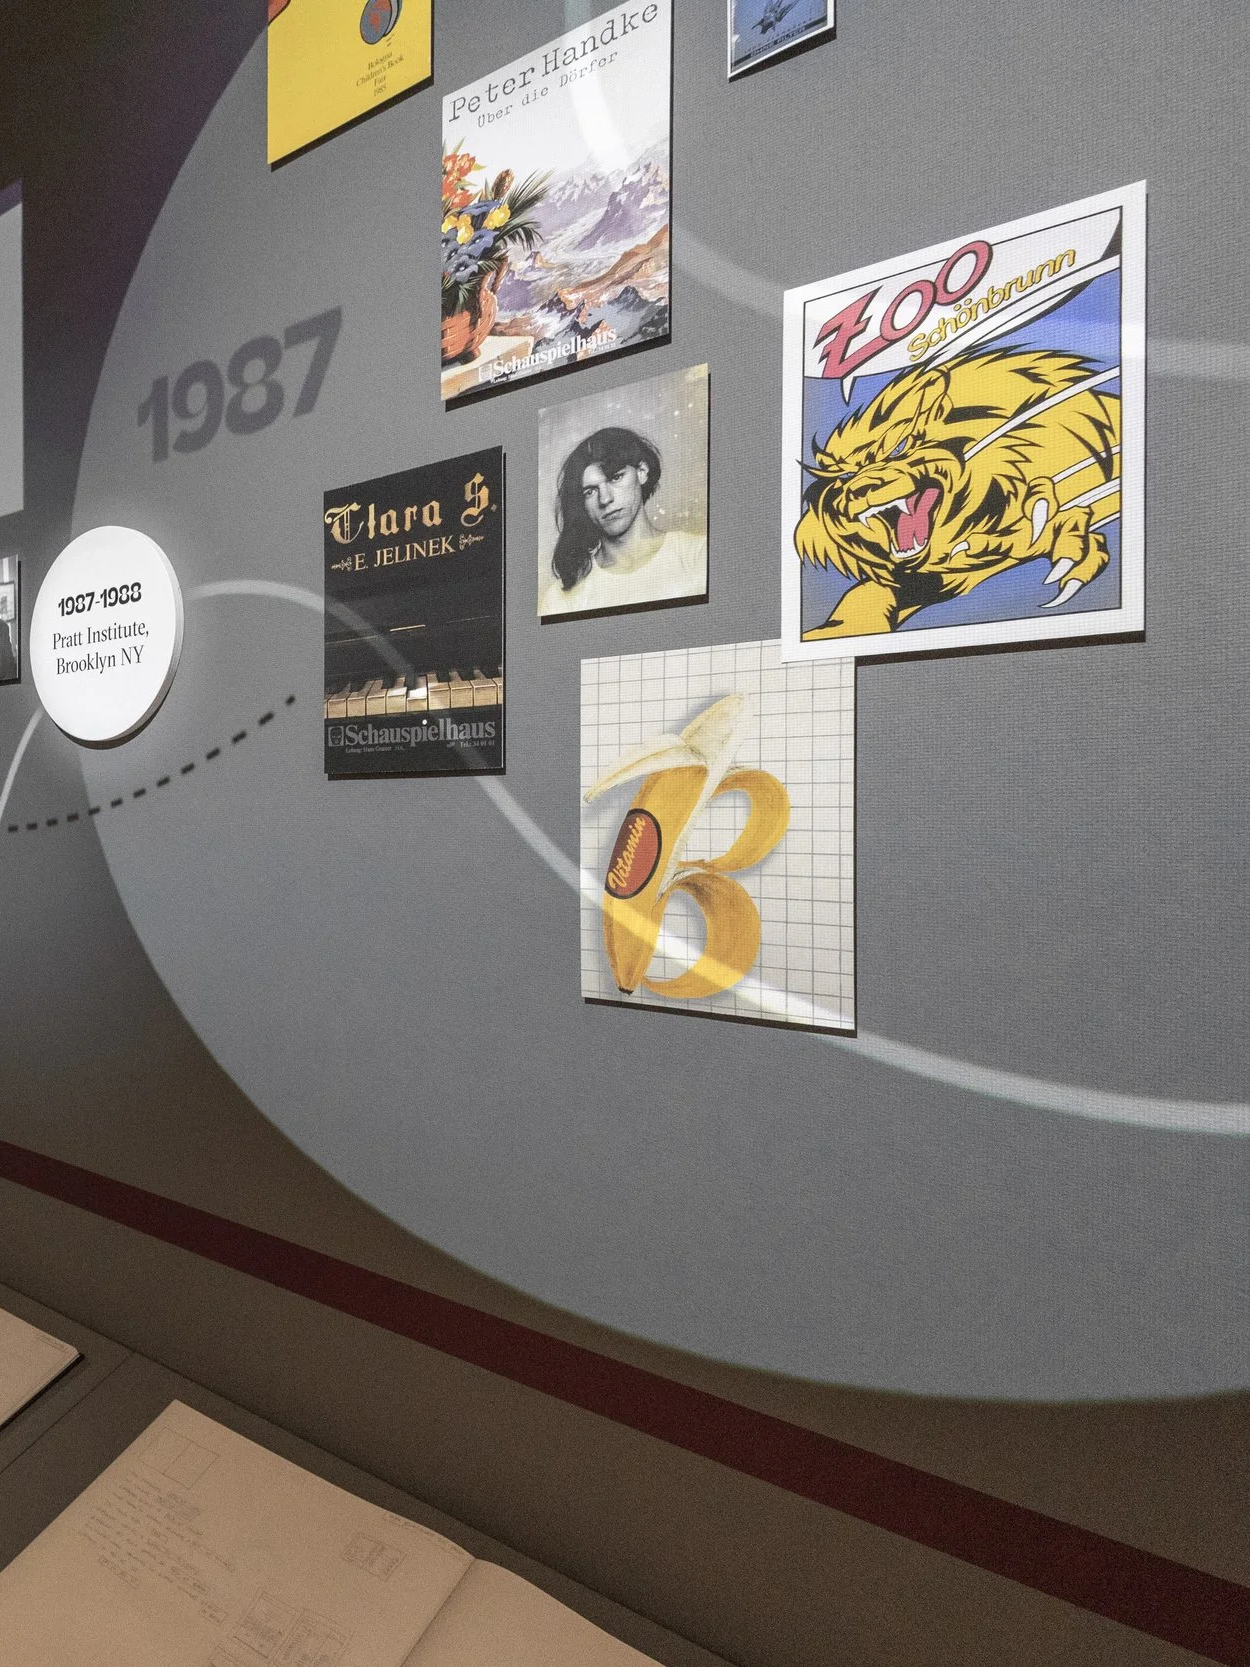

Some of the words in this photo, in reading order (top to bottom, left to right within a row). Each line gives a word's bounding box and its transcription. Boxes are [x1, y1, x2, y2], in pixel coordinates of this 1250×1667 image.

[448, 66, 535, 122] Peter
[541, 3, 659, 78] Handke
[521, 86, 549, 106] die
[559, 51, 618, 88] Dörfer
[813, 239, 993, 379] ZOO
[907, 247, 1077, 362] Schönbrunn
[493, 328, 617, 377] Schauspielhaus
[136, 305, 343, 464] 1987
[354, 553, 368, 571] E.
[374, 535, 456, 568] JELINEK
[58, 582, 142, 617] 1987-1988
[52, 632, 83, 650] Pratt
[87, 621, 149, 644] Institute,
[56, 652, 116, 675] Brooklyn
[121, 645, 144, 666] NY
[345, 718, 496, 747] Schauspielhaus
[607, 815, 647, 889] Vitamin
